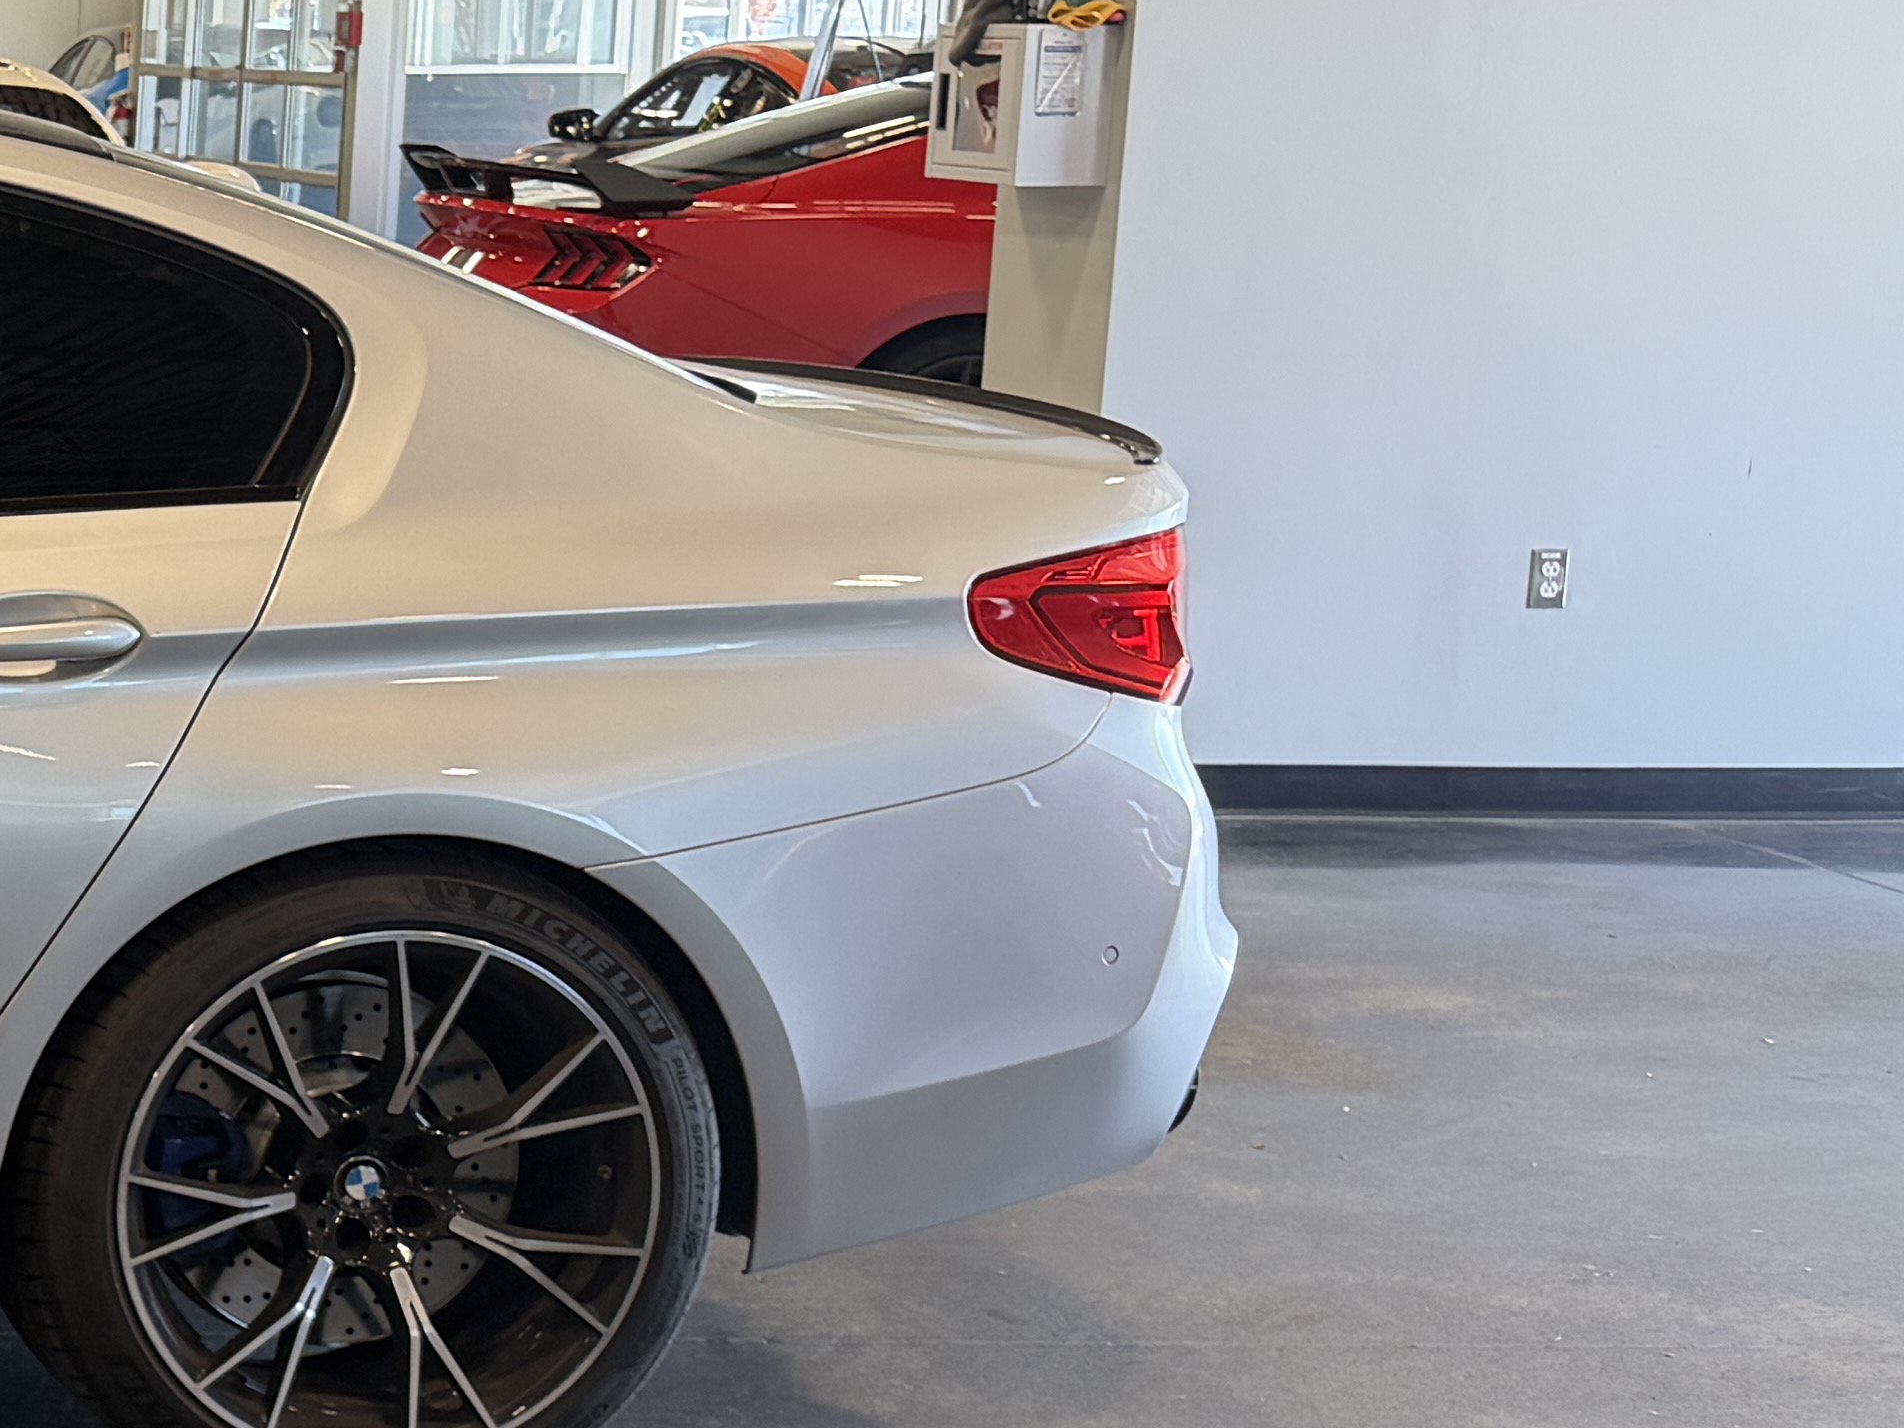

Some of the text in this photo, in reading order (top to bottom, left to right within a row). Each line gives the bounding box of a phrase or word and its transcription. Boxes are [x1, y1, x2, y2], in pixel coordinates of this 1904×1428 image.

[485, 893, 668, 1040] MICHELIN
[672, 1056, 698, 1114] PILOT
[690, 1122, 706, 1194] SPORT
